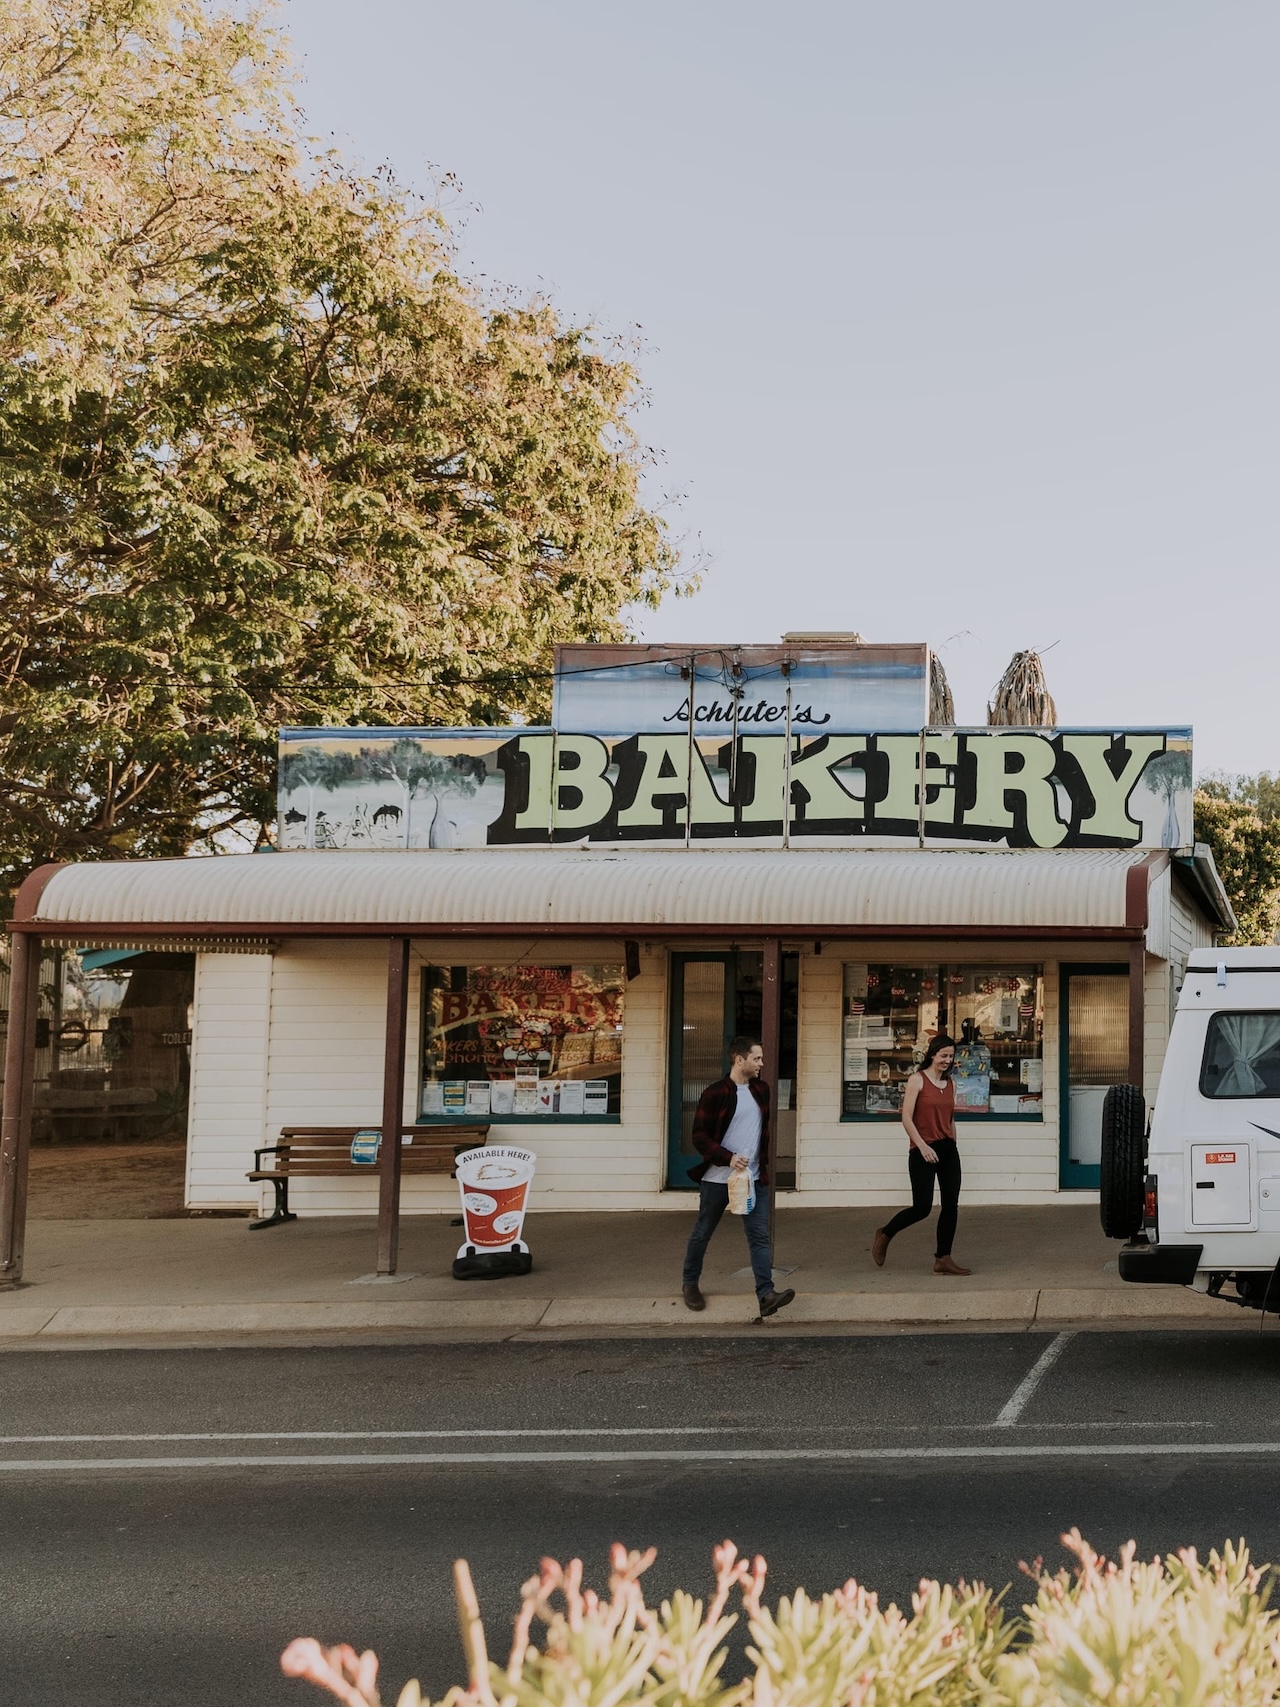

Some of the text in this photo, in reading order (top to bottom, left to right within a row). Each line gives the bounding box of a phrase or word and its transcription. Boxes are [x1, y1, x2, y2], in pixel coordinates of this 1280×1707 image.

[663, 697, 831, 724] Schluter's
[487, 732, 1167, 848] BAKERY
[436, 991, 624, 1029] BAKERY
[463, 1150, 531, 1164] AVAILABLE HERE!
